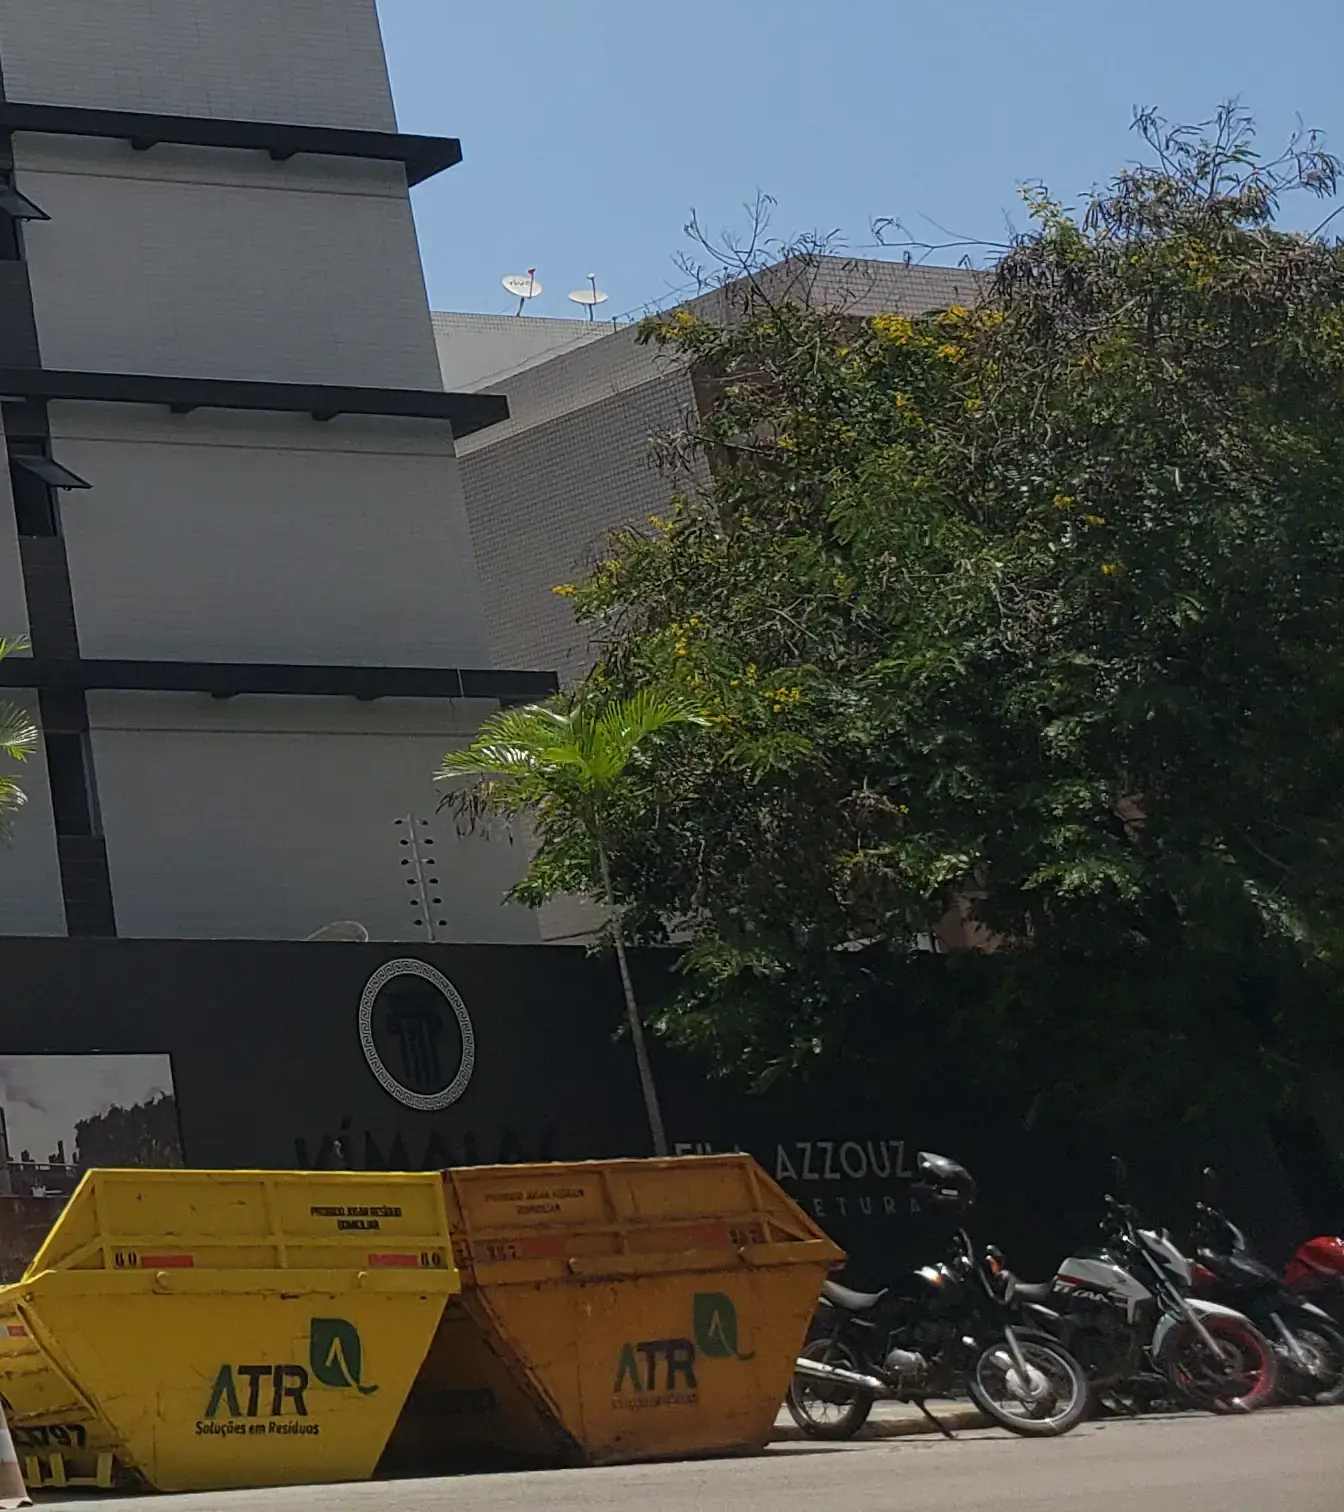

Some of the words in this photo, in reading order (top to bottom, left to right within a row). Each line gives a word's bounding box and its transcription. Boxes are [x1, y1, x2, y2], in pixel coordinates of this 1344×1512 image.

[775, 1141, 912, 1180] AZZOUZ
[793, 1195, 922, 1217] ETURA
[613, 1338, 698, 1392] ATR
[205, 1364, 309, 1418] ATR
[195, 1420, 246, 1438] Soluções
[249, 1423, 266, 1435] em
[268, 1420, 320, 1435] Resíduos
